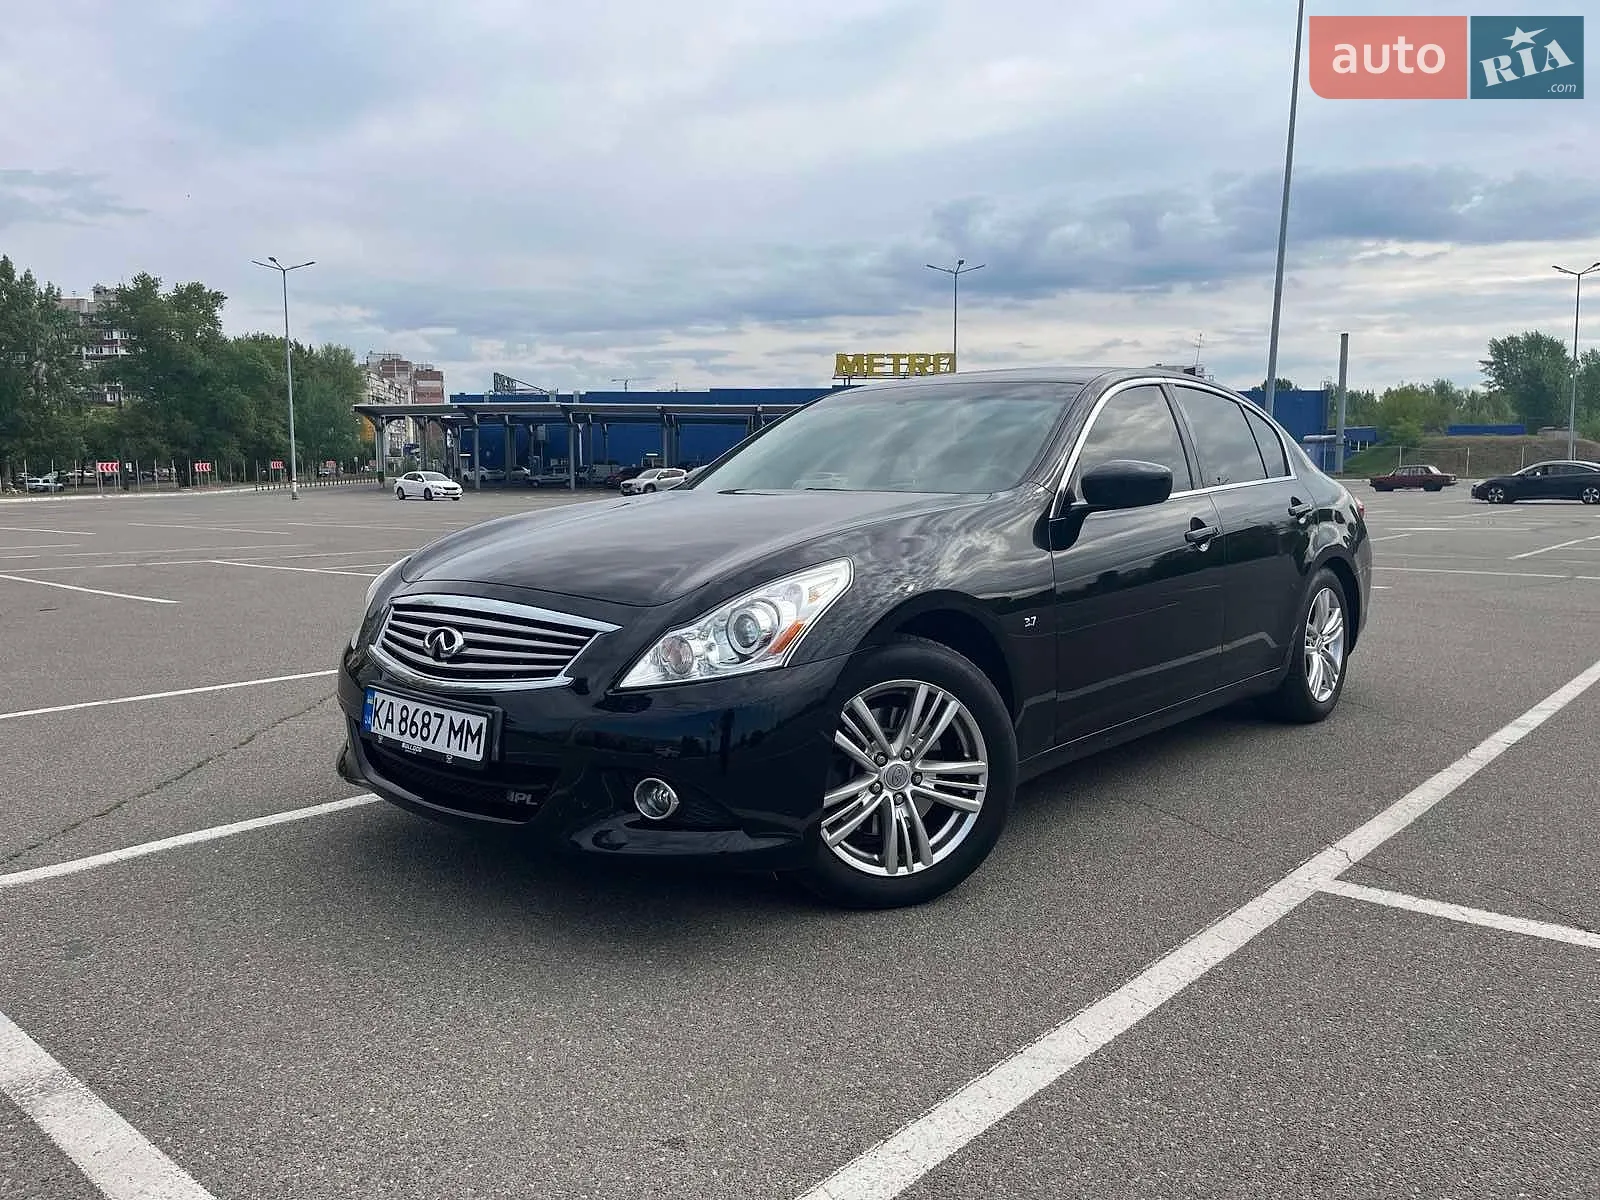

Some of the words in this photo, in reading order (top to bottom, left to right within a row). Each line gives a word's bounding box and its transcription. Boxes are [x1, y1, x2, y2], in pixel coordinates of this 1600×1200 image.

[836, 353, 956, 376] METRO
[372, 697, 394, 733] KA
[398, 705, 445, 744] 8687
[447, 716, 483, 755] MM
